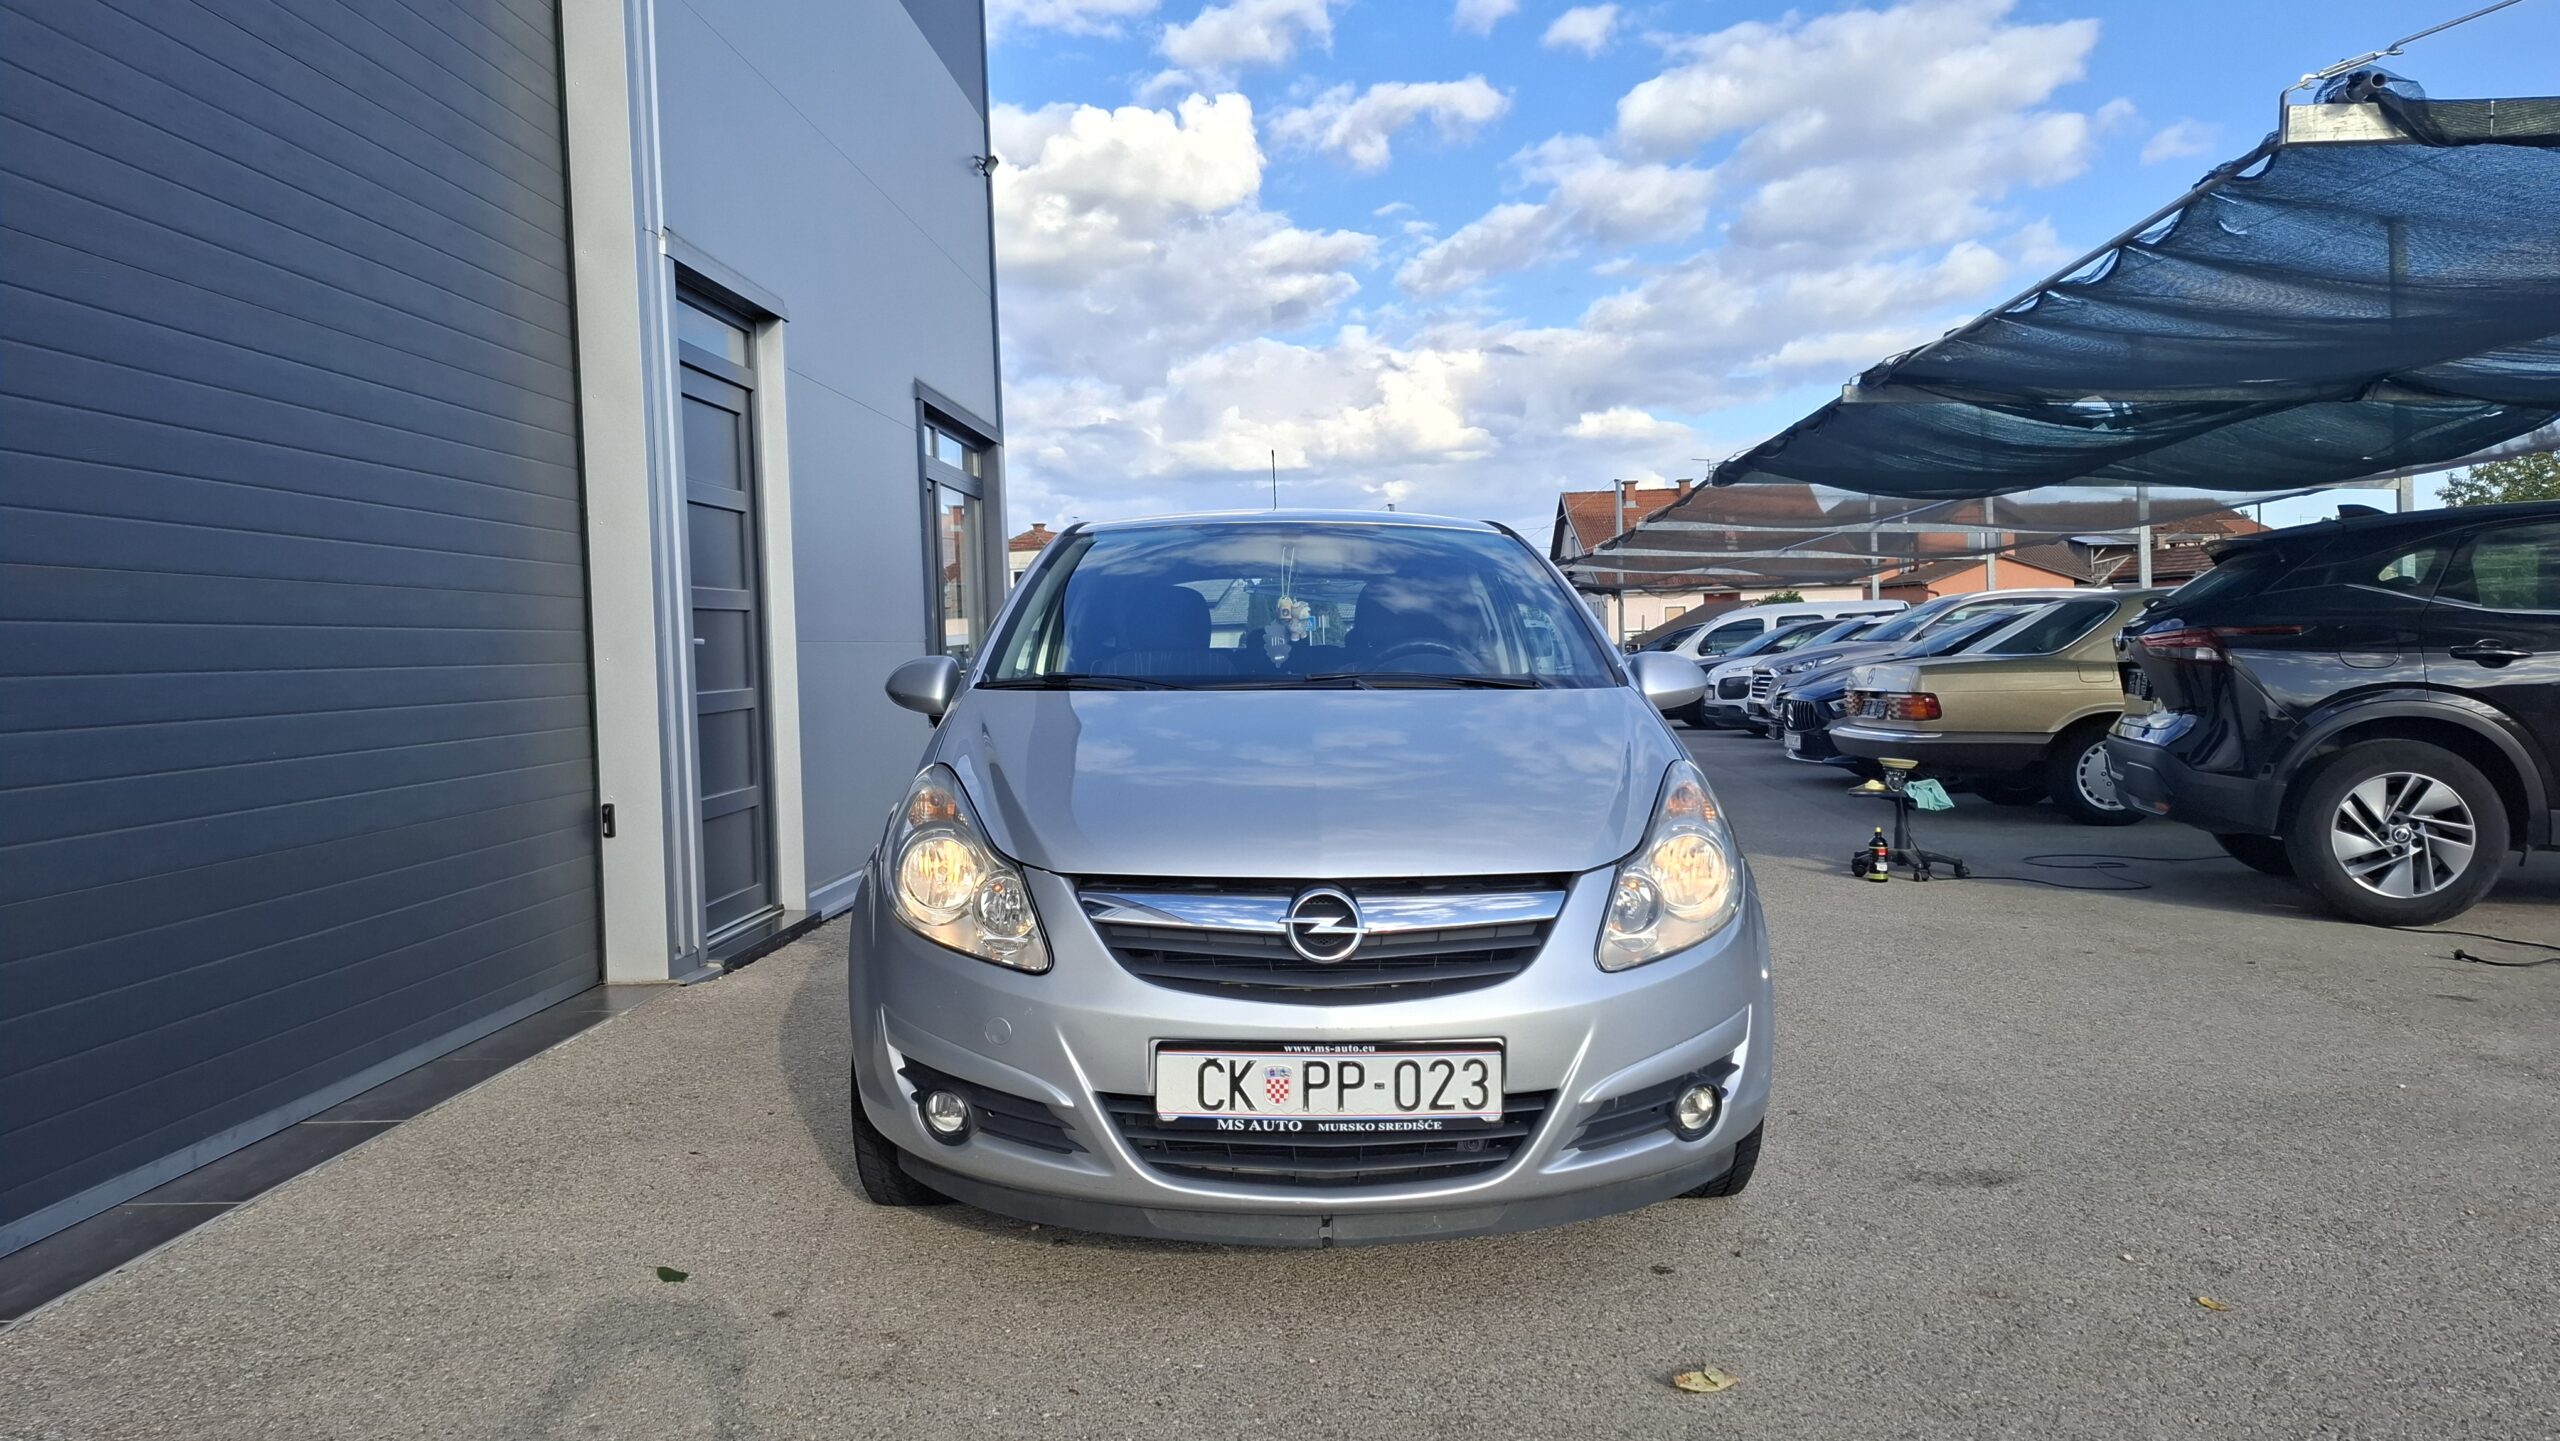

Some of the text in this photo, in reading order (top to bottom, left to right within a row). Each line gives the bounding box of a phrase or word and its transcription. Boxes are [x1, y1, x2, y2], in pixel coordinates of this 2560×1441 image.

[1284, 1045, 1376, 1053] www.ms-auto.eu
[1197, 1057, 1489, 1113] ČK PP-023
[1217, 1119, 1245, 1131] MS
[1249, 1120, 1303, 1132] AUTO
[1317, 1122, 1376, 1132] MURSKO
